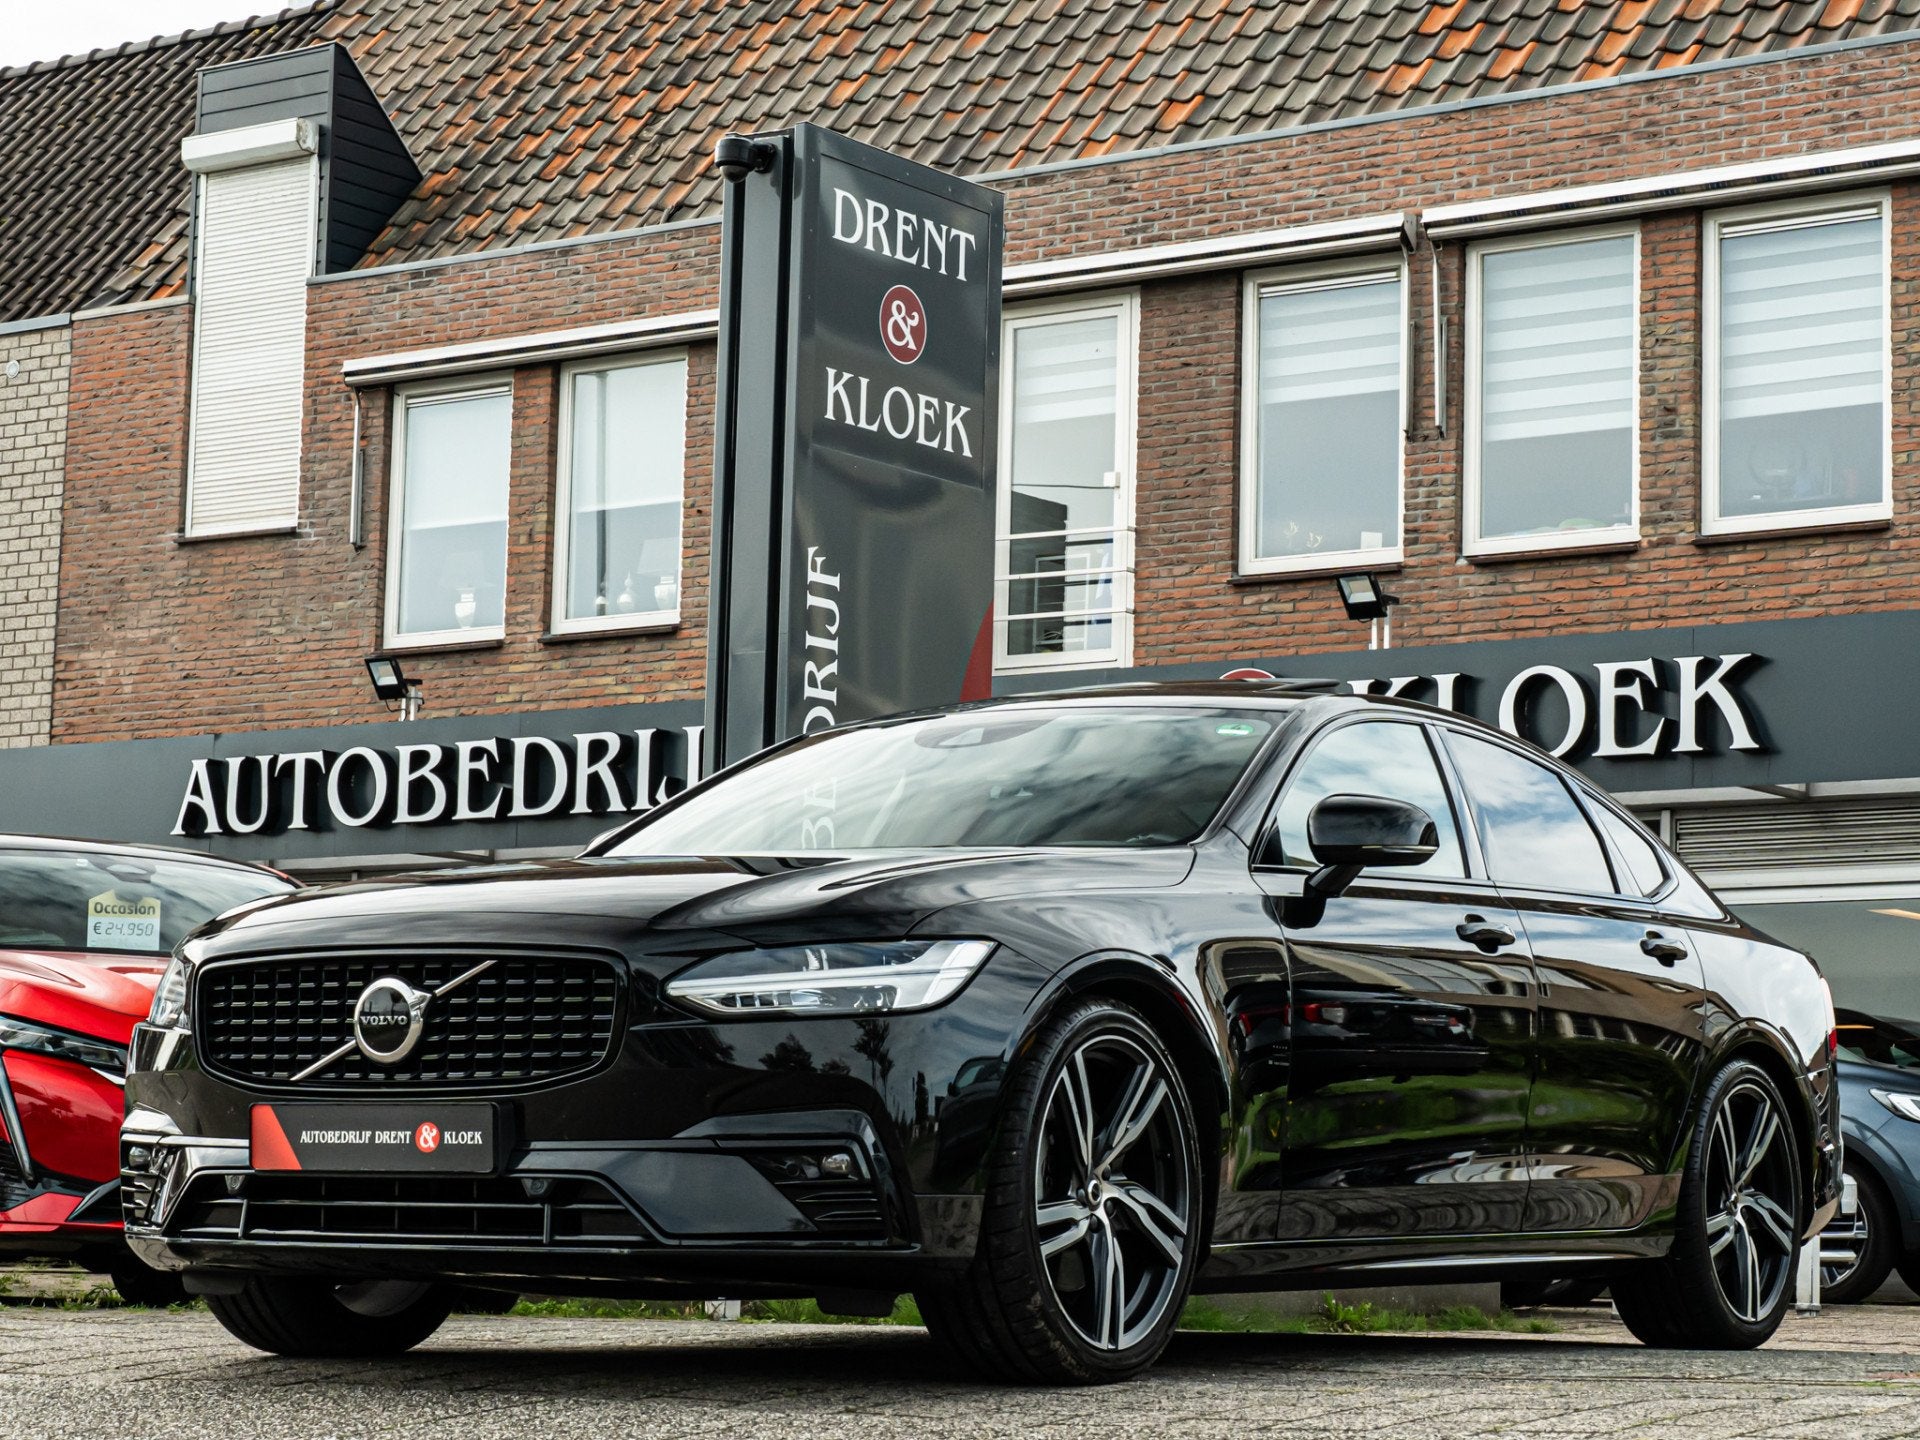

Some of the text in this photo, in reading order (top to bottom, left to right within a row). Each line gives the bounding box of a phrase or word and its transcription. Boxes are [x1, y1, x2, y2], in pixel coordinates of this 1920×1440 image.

[832, 187, 976, 282] DRENT
[887, 300, 919, 350] &
[824, 366, 973, 458] KLOEK
[1346, 652, 1759, 758] OEK
[93, 901, 156, 915] Occasion
[360, 1015, 408, 1025] VOLVO
[300, 1125, 483, 1148] AUTOBEDRIJF DRENT & KLOEK
